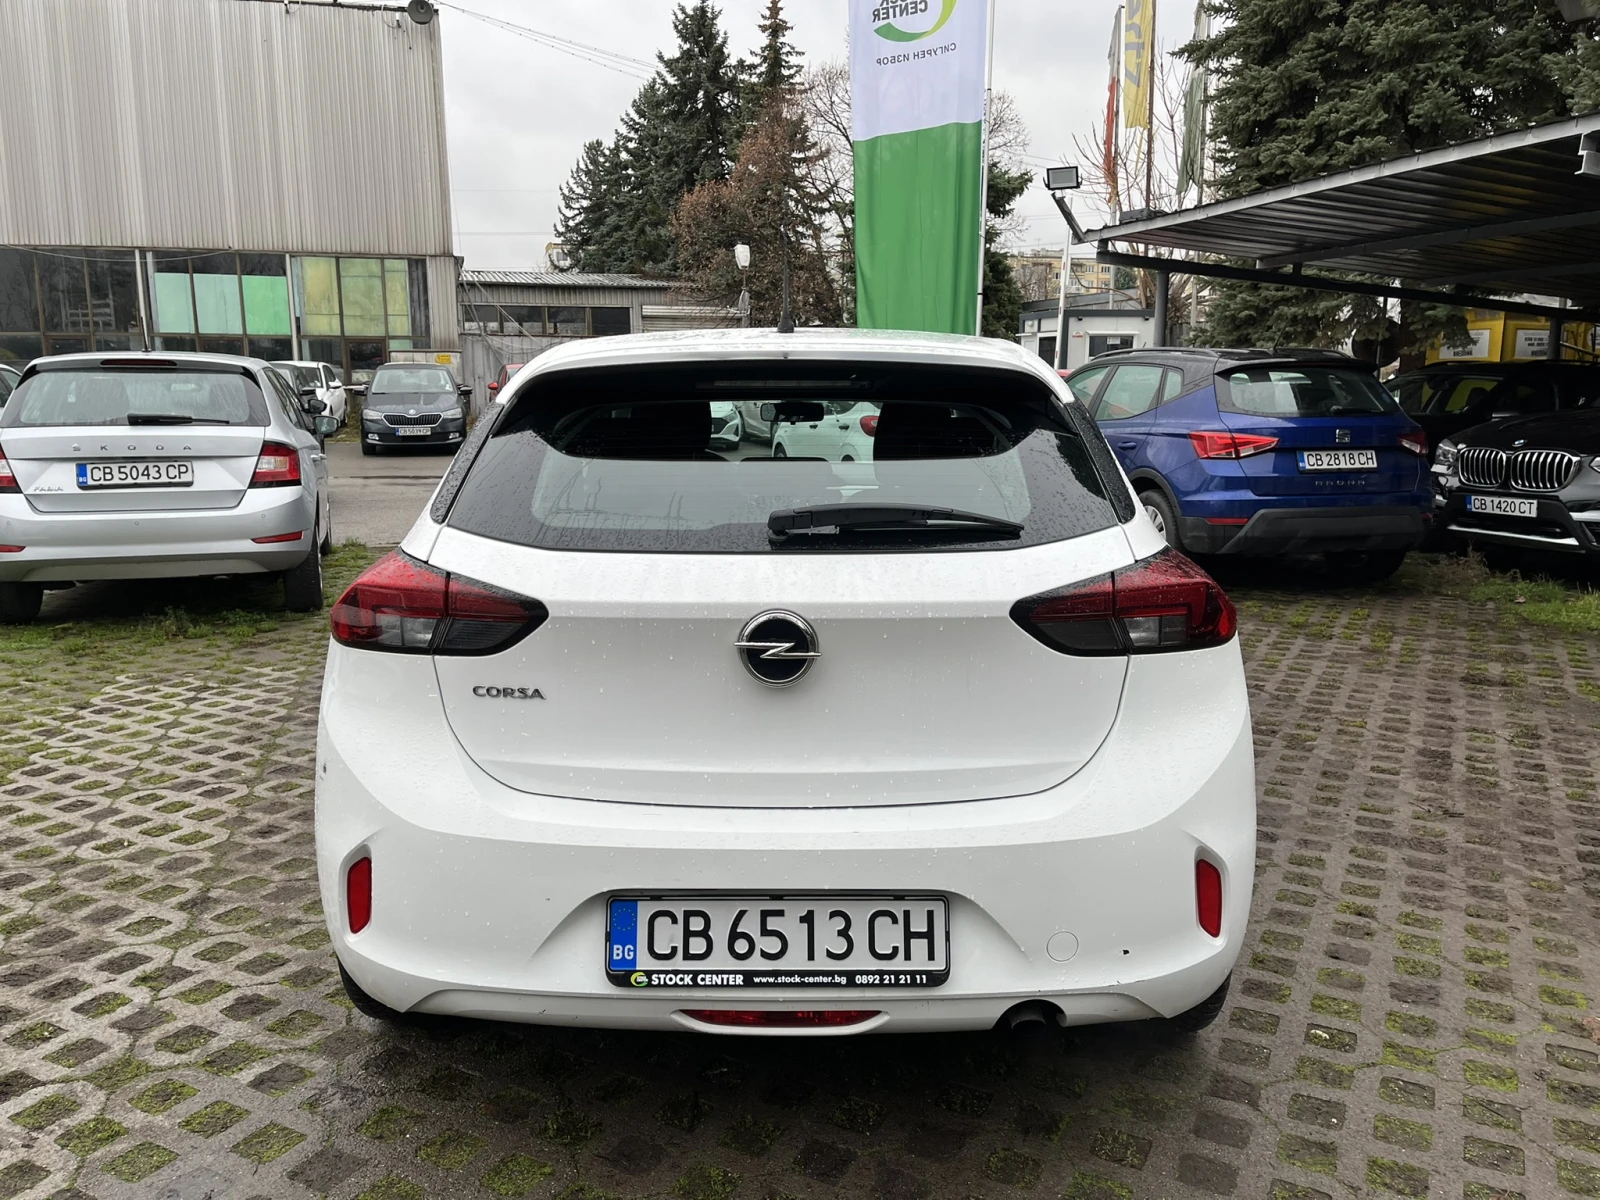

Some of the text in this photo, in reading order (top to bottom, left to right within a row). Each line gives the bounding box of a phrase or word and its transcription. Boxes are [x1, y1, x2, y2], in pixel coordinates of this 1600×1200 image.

[1307, 453, 1324, 467] CB
[1325, 453, 1356, 466] 2818
[1358, 452, 1375, 466] CH
[90, 464, 189, 482] CB 5043 CP
[1473, 497, 1535, 515] CB 1420 CT
[472, 685, 547, 700] CORSA
[647, 909, 936, 962] CB 6513 CH
[612, 945, 635, 960] BG
[651, 974, 693, 985] STOCK
[697, 974, 744, 985] CENTER
[753, 974, 847, 984] www.stock-center.bg
[855, 974, 927, 984] 0892 21 21 11
